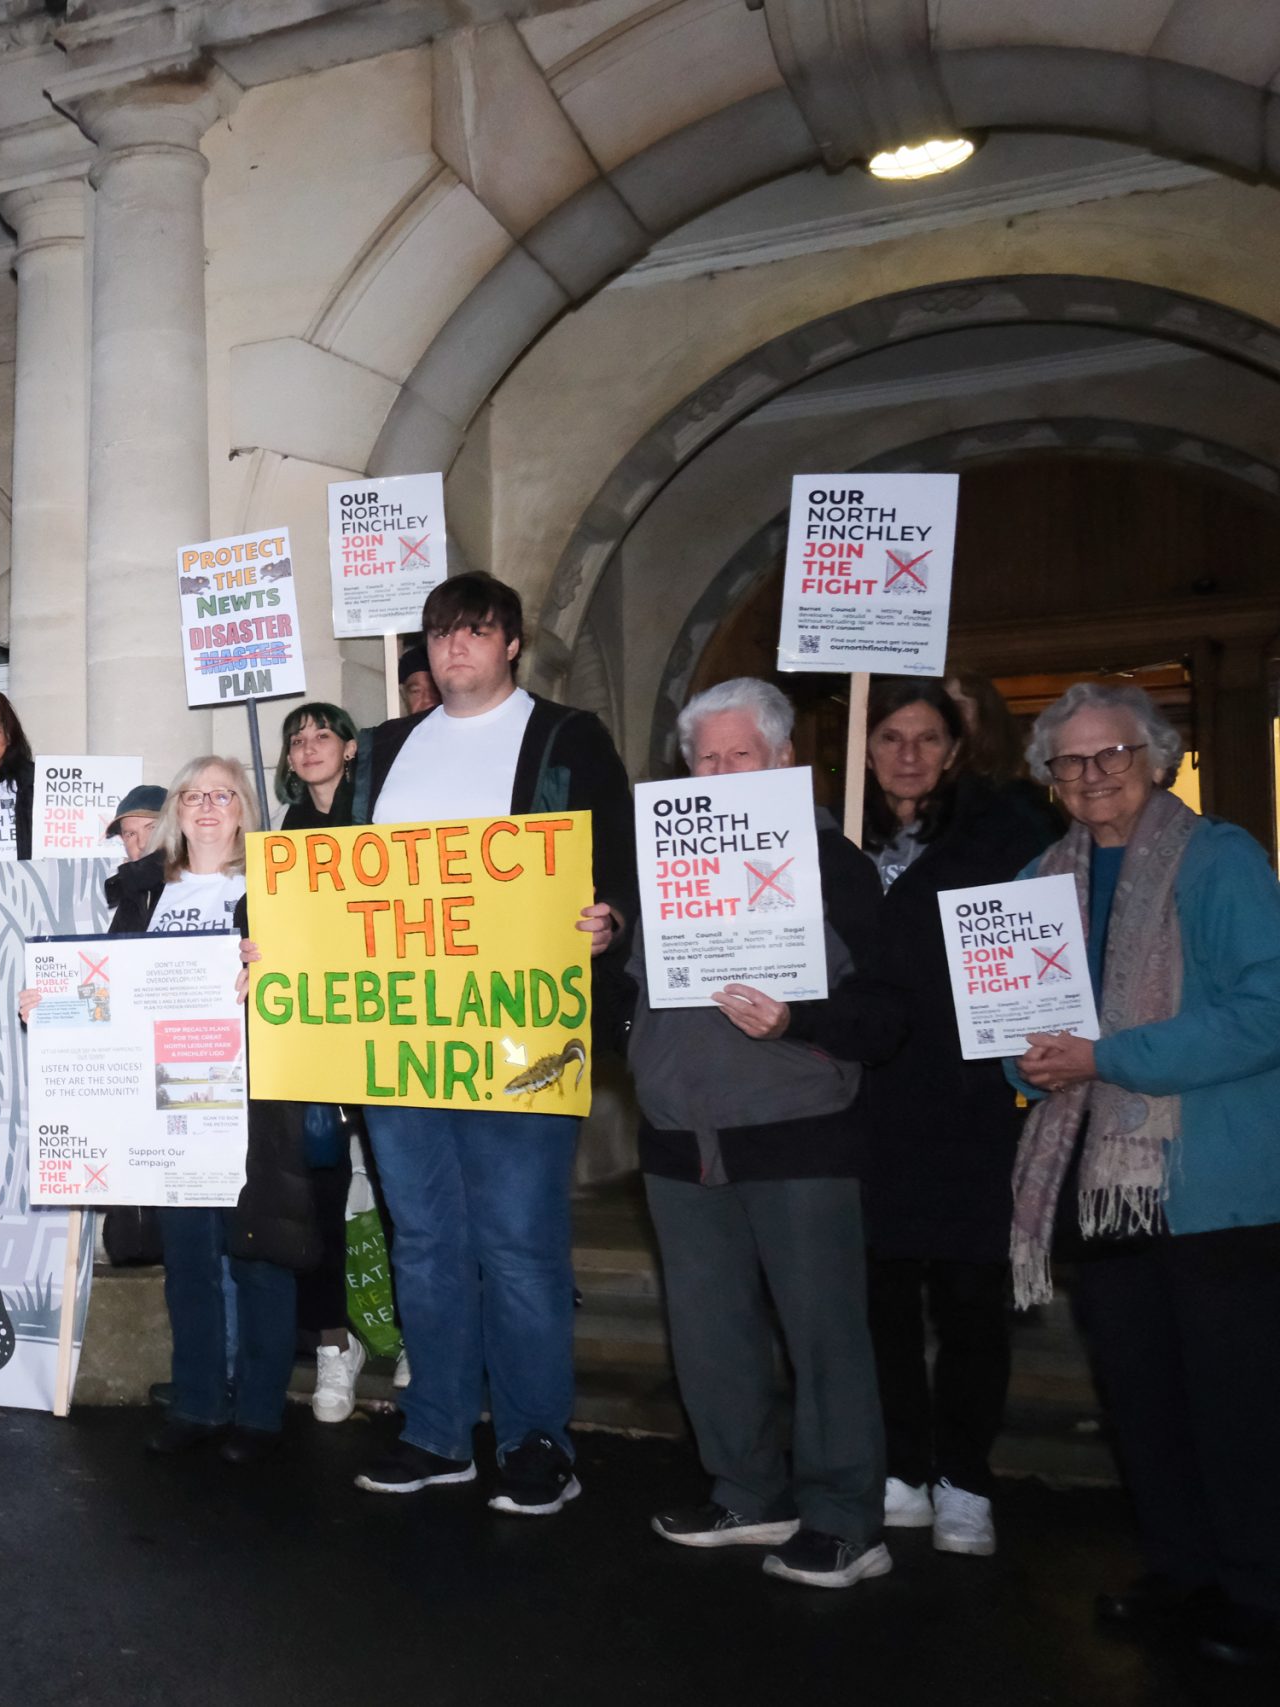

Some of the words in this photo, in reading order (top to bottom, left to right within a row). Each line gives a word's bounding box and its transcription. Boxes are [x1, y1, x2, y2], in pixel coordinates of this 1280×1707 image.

[340, 492, 379, 506] OUR
[809, 490, 864, 504] OUR
[341, 504, 402, 520] NORTH
[808, 507, 896, 522] NORTH
[342, 515, 428, 535] FINCHLEY
[807, 525, 932, 541] FINCHLEY
[342, 534, 383, 549] JOIN
[182, 537, 285, 572] PROTECT
[343, 549, 377, 562] THE
[803, 543, 864, 558] JOIN
[344, 561, 396, 577] FIGHT
[803, 561, 852, 576] THE
[213, 567, 257, 590] THE
[802, 579, 877, 595] FIGHT
[196, 588, 280, 618] NEWTS
[189, 614, 292, 650] DISASTER
[830, 645, 919, 653] ournorthfinchley.org
[200, 641, 287, 674] MASTER
[219, 669, 272, 698] PLAN
[653, 796, 712, 816] OUR
[655, 813, 749, 837] NORTH
[656, 830, 789, 857] FINCHLEY
[264, 819, 573, 895] PROTECT
[656, 857, 720, 879] JOIN
[657, 879, 711, 899] THE
[660, 898, 741, 920] FIGHT
[956, 900, 1002, 917] OUR
[347, 896, 478, 959] THE
[959, 911, 1033, 933] NORTH
[961, 923, 1063, 948] FINCHLEY
[963, 946, 1014, 964] JOIN
[701, 971, 797, 982] ournorthfinchley.org
[964, 963, 1008, 979] THE
[968, 976, 1031, 995] FIGHT
[256, 966, 586, 1029] GLEBELANDS
[72, 1064, 83, 1072] TO
[107, 1063, 142, 1071] VOICES!
[365, 1040, 494, 1101] LNR!
[45, 1077, 66, 1085] THEY
[68, 1077, 85, 1085] ARE
[107, 1076, 139, 1084] SOUND
[45, 1089, 56, 1097] OF
[78, 1088, 138, 1096] COMMUNITY!
[39, 1125, 69, 1135] OUR
[39, 1137, 87, 1147] NORTH
[39, 1148, 107, 1159] FINCHLEY
[129, 1148, 165, 1157] Support
[168, 1148, 185, 1156] Our
[39, 1160, 72, 1170] JOIN
[129, 1159, 175, 1168] Campaign
[39, 1172, 67, 1182] THE
[40, 1183, 81, 1194] FIGHT
